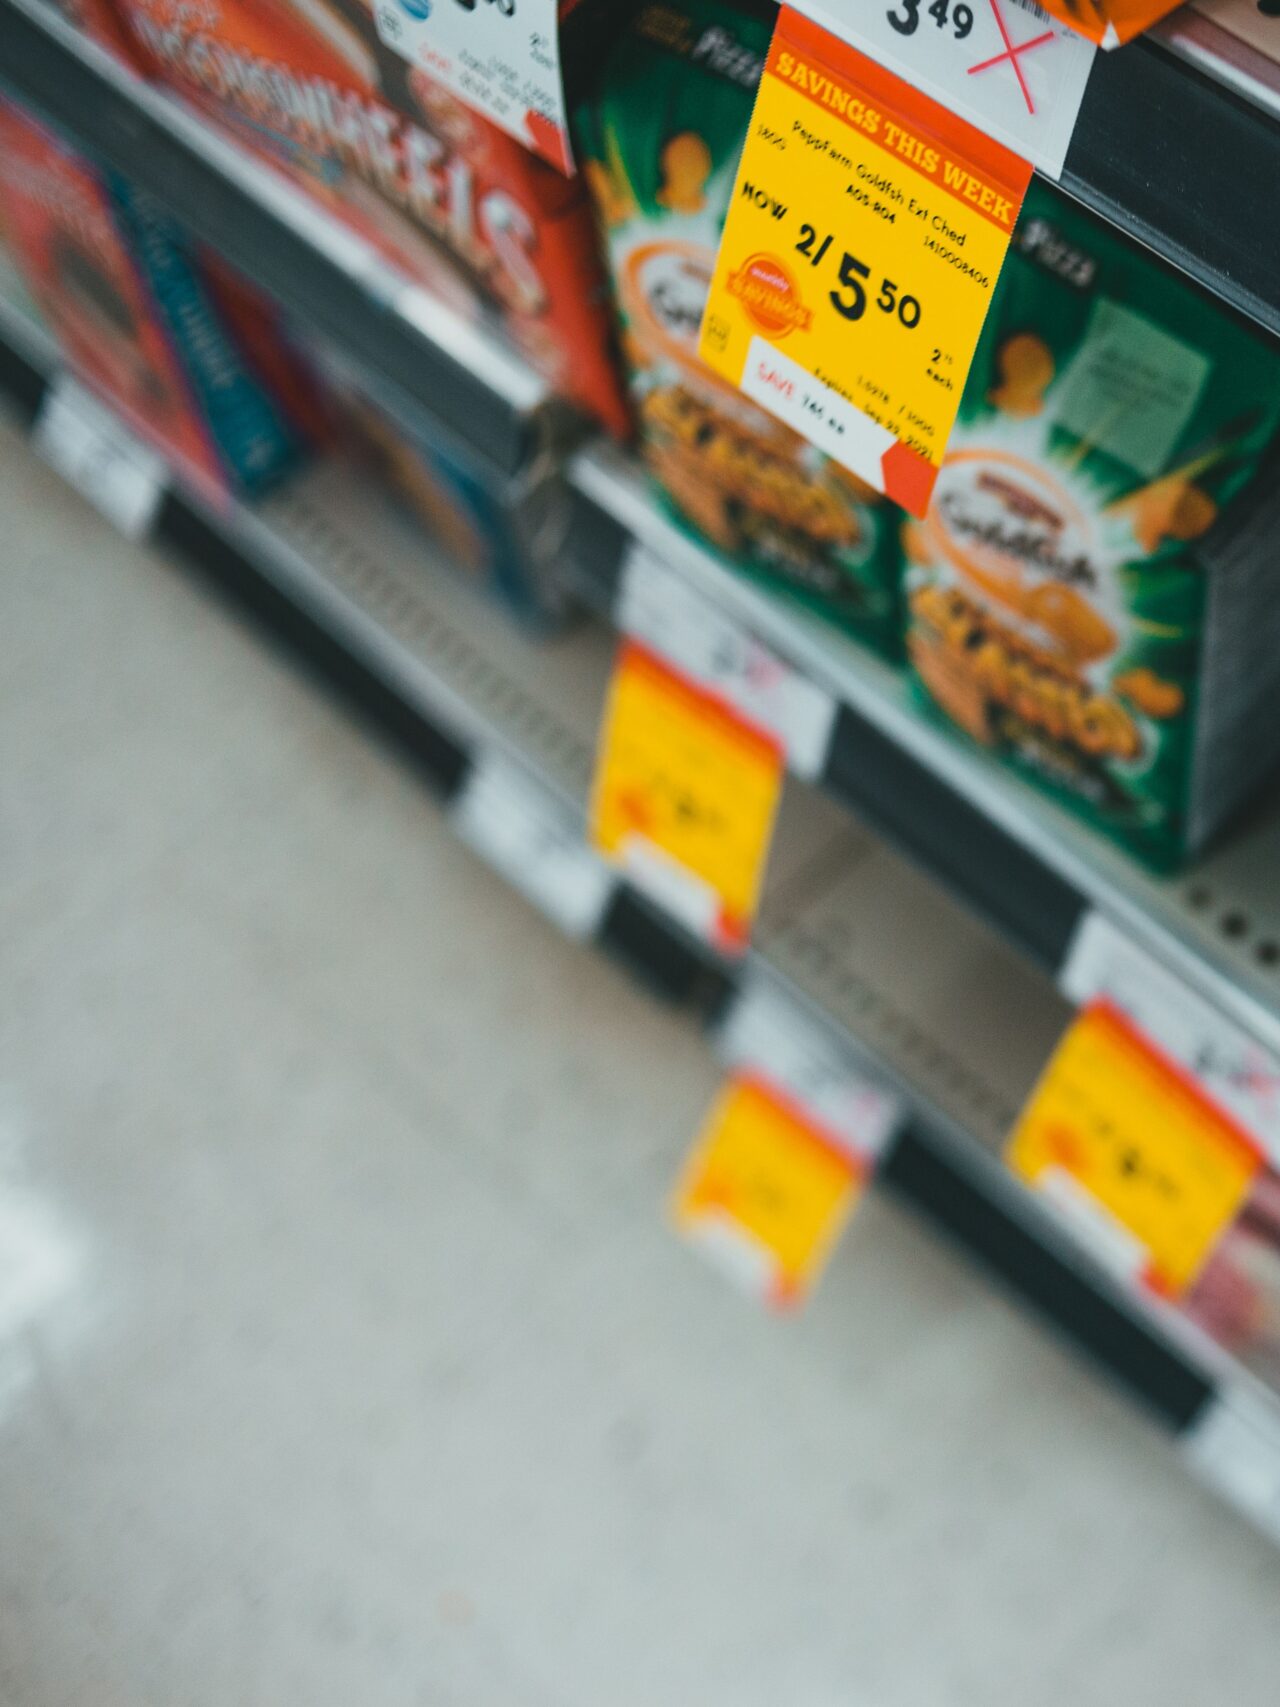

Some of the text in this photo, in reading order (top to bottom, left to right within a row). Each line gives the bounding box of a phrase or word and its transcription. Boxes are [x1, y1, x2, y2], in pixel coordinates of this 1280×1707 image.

[928, 0, 974, 39] 49
[776, 52, 1014, 224] SAVINGS THIS WEEK
[742, 181, 788, 221] NOW
[792, 120, 967, 246] PeppFarm Goldfish Ext Ched
[846, 184, 896, 224] A05-R04
[795, 224, 834, 266] 2/
[876, 279, 921, 329] 50
[924, 236, 989, 288] 1410008406
[931, 349, 941, 363] 2
[758, 361, 794, 400] SAVE
